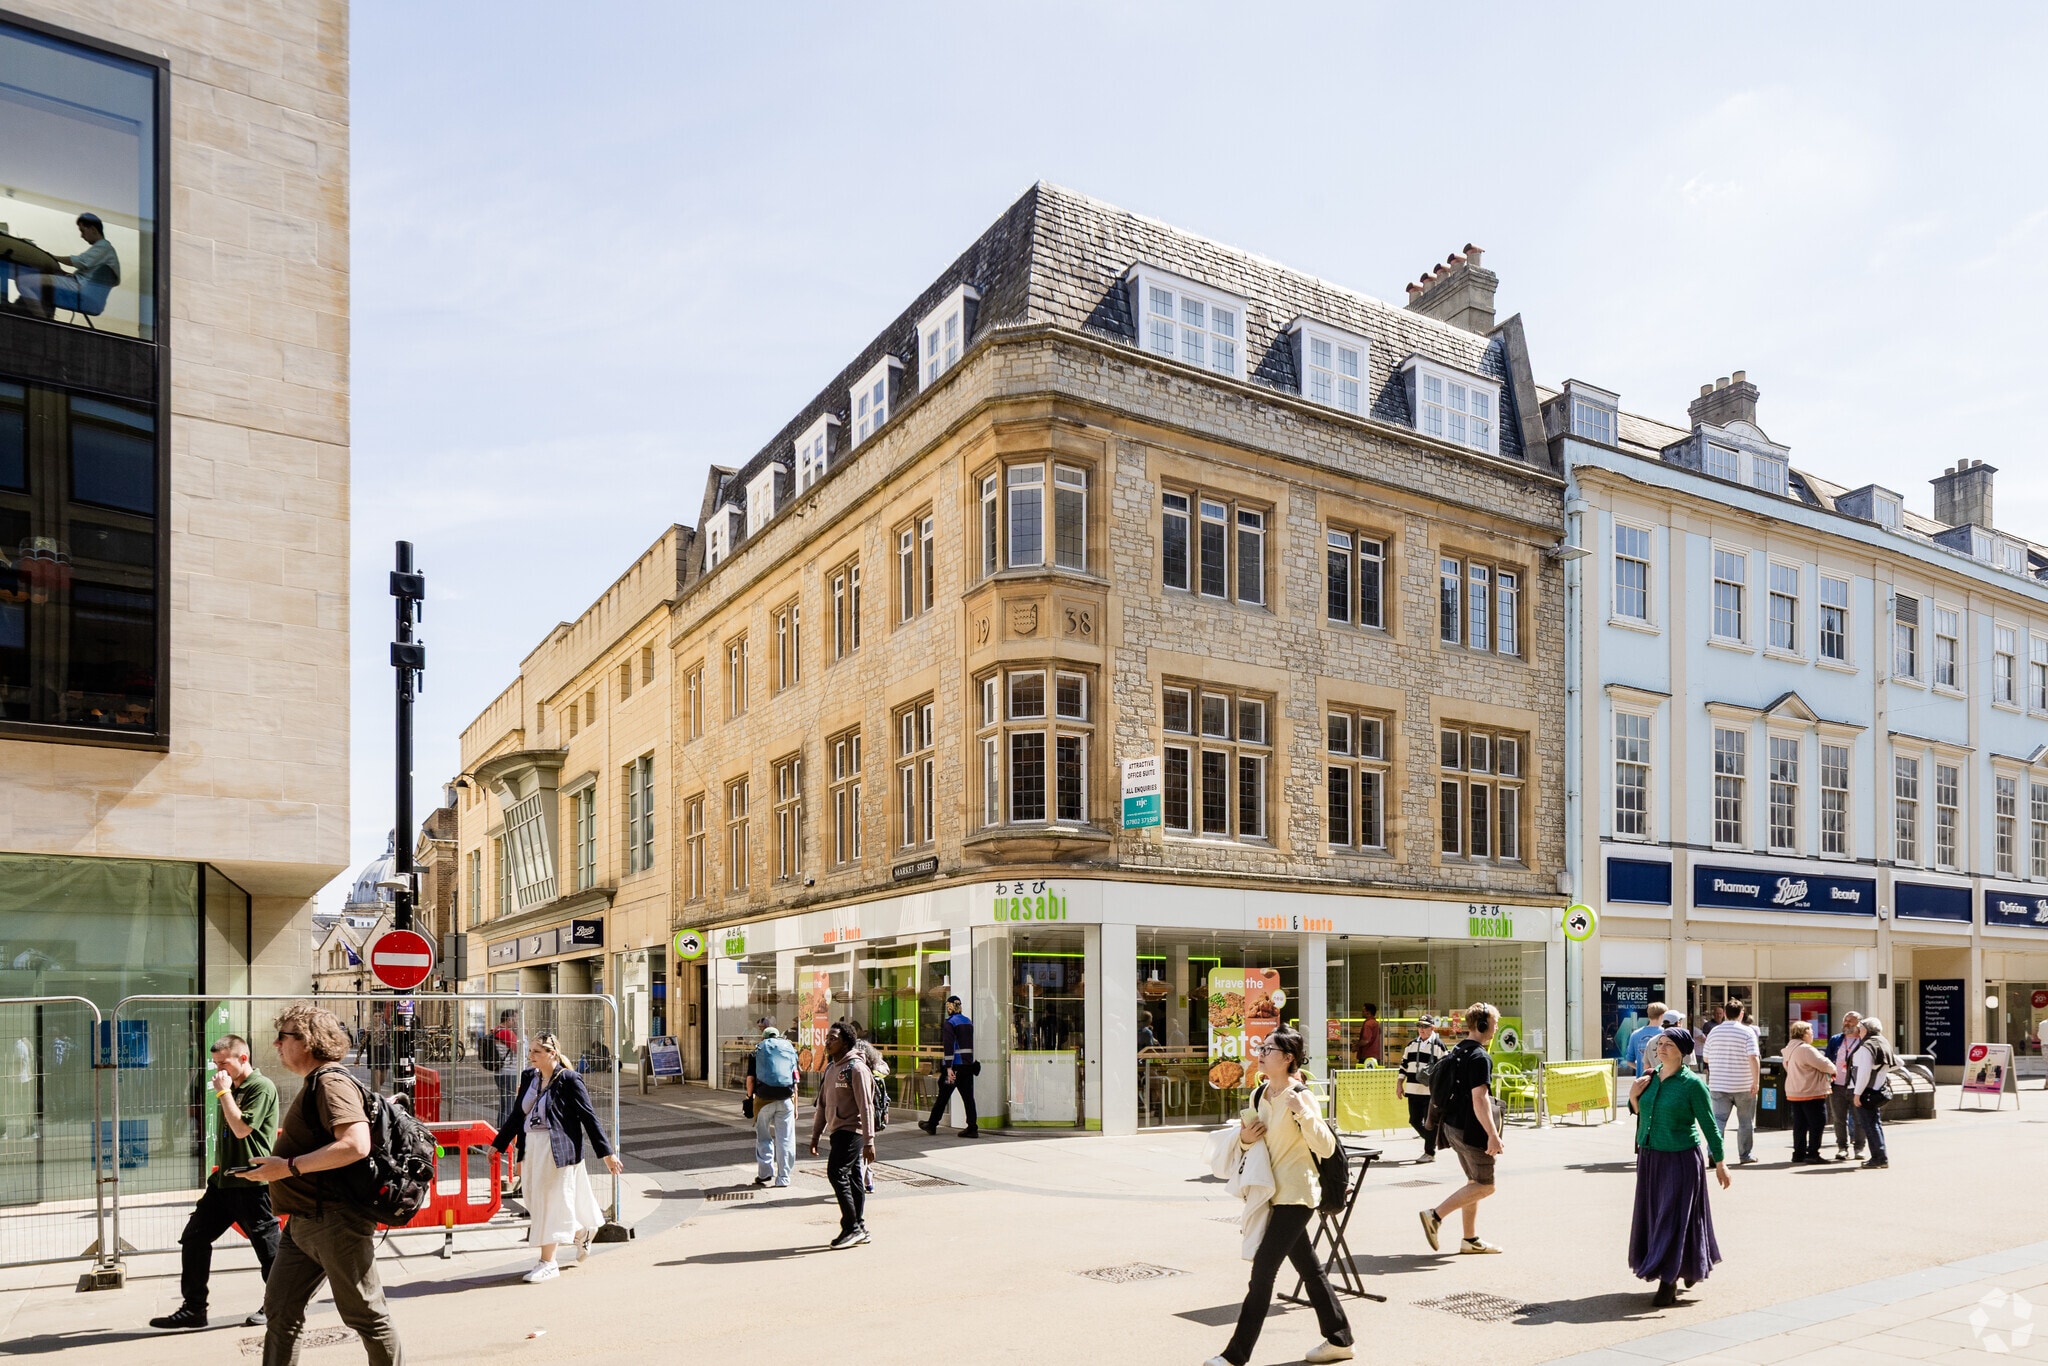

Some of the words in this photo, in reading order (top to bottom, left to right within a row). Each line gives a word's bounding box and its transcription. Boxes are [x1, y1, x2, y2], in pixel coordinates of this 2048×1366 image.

[1065, 607, 1091, 635] 38
[1129, 760, 1154, 769] ATTRACTIVE
[1127, 771, 1141, 779] OFFICE
[1143, 769, 1155, 777] SUITE
[1134, 784, 1157, 793] ENQUIRIES
[894, 865, 914, 876] MARKET
[917, 861, 934, 871] STREET
[995, 881, 1046, 895] わさび
[1714, 879, 1760, 898] Pharmacy
[1773, 877, 1808, 905] Boots
[1831, 887, 1860, 903] Beauty
[994, 888, 1066, 921] wasabi
[1468, 904, 1500, 915] わさび
[1999, 901, 2028, 915] Opticians
[1257, 913, 1287, 929] sushi
[1293, 915, 1298, 930] &
[1303, 915, 1332, 931] bento
[1469, 912, 1513, 937] wasabi
[823, 928, 838, 943] sushi
[845, 926, 861, 940] bento
[1214, 977, 1244, 989] krave
[1246, 977, 1263, 989] the
[1617, 992, 1648, 1000] REVERSE
[1582, 1098, 1597, 1108] FRESH
